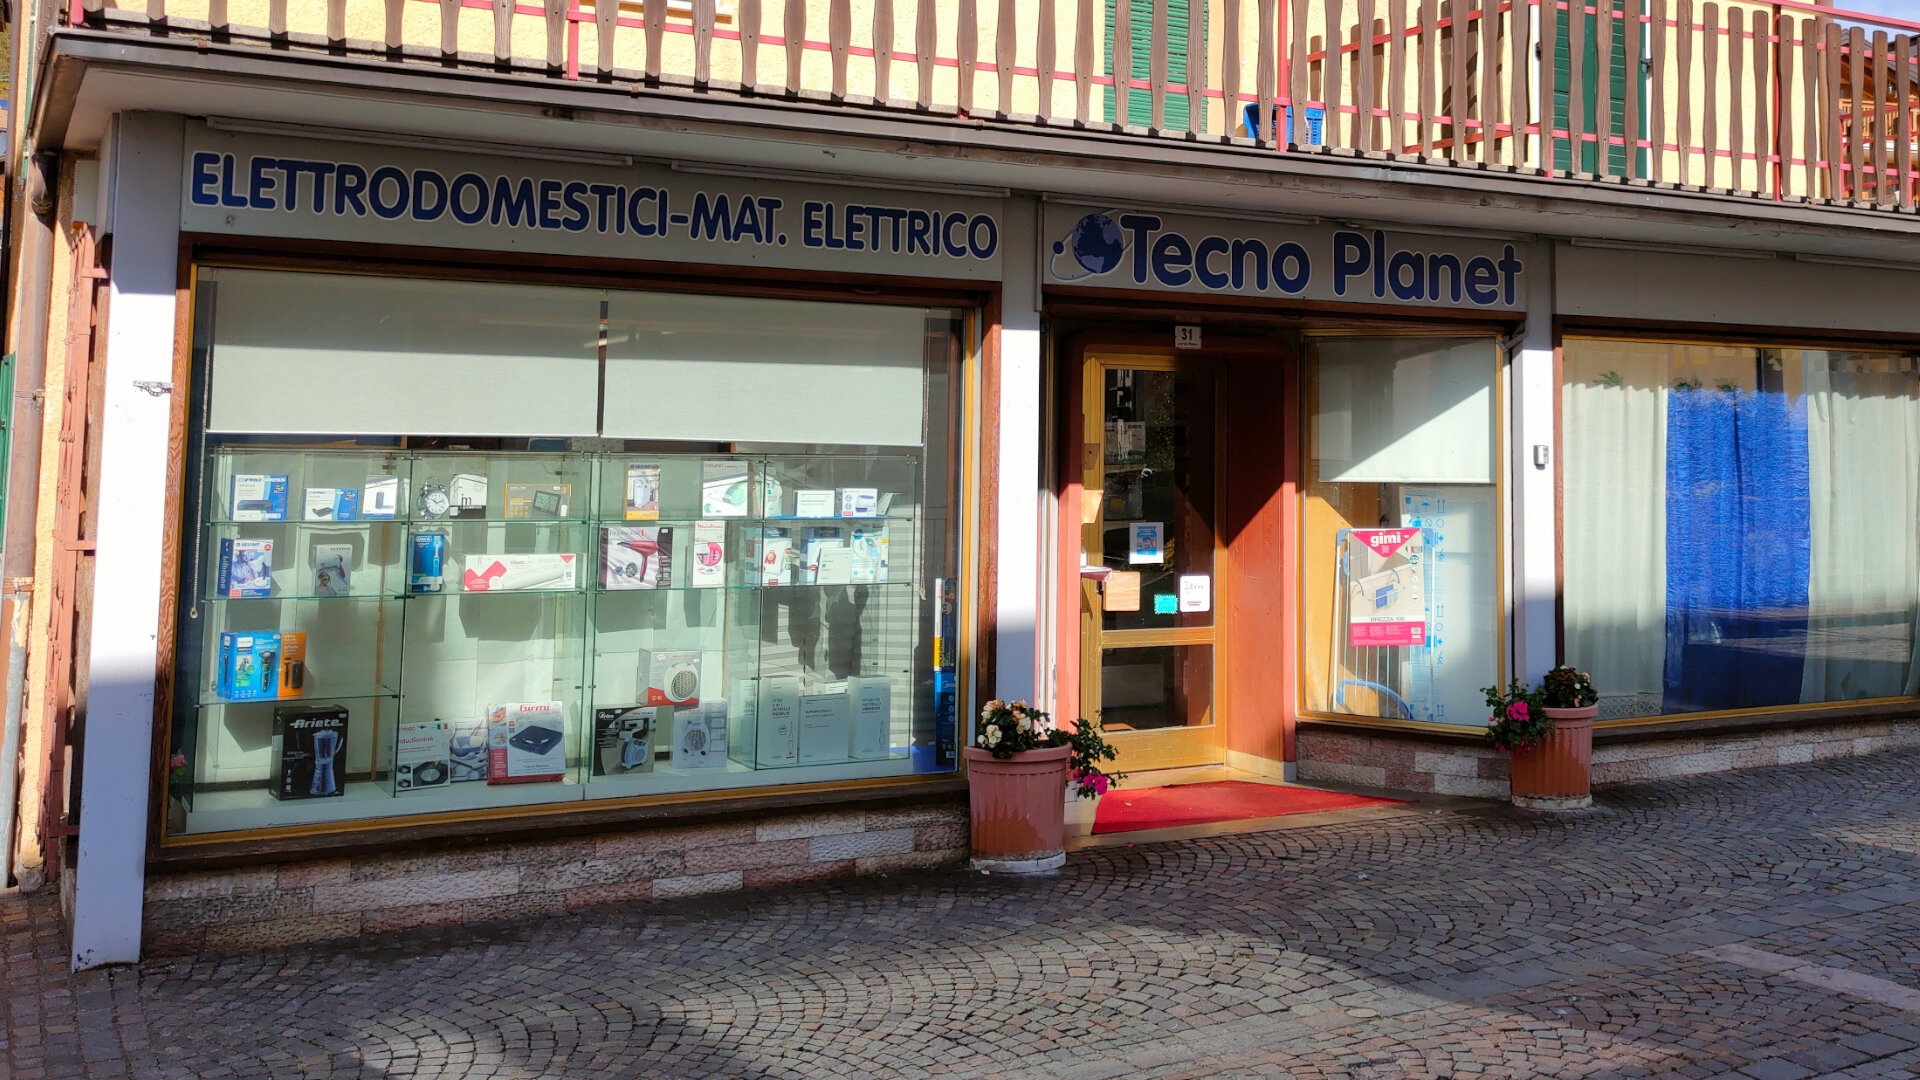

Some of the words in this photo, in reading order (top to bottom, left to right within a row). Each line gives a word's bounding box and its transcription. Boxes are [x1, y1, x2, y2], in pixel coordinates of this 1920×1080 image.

[803, 202, 999, 260] ELETTRICO
[1119, 213, 1312, 295] Tecno
[1333, 229, 1524, 306] Planet
[1181, 327, 1193, 341] 31
[1370, 532, 1401, 547] gimi
[290, 718, 344, 729] Ariete
